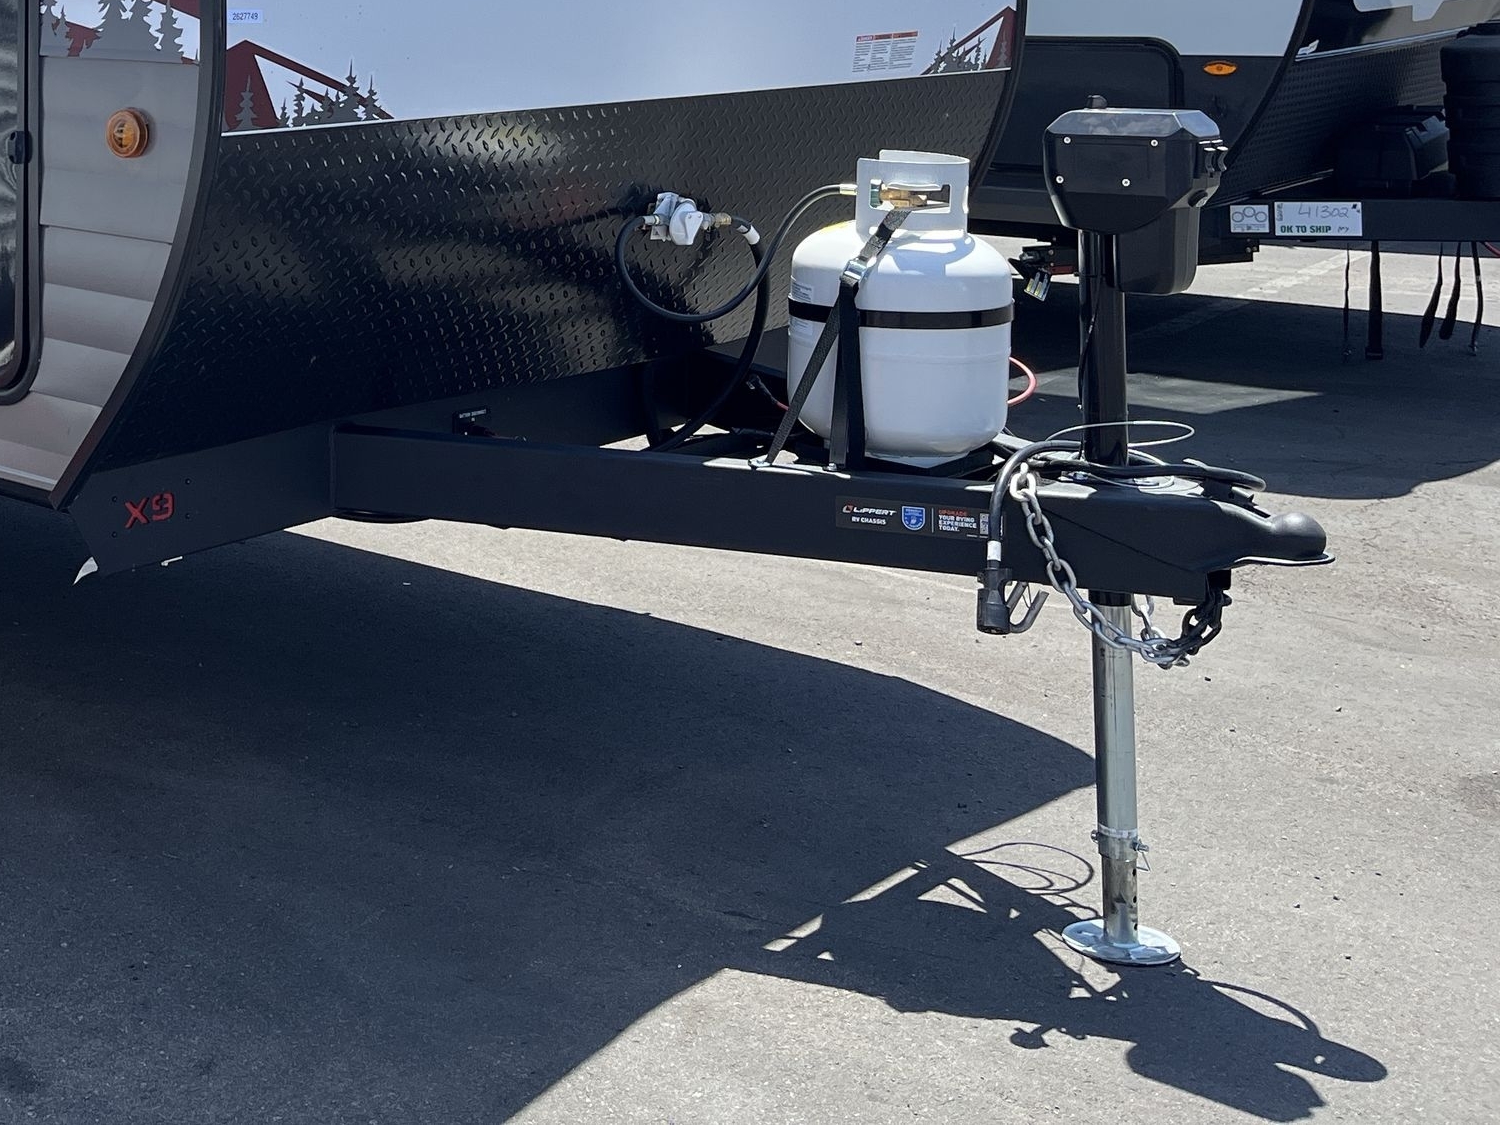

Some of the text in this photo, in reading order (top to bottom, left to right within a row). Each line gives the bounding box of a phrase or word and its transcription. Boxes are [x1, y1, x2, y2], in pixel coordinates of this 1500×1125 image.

[1280, 225, 1332, 234] OK TO SHIP
[124, 492, 174, 529] X9
[853, 506, 898, 517] LIPPERT
[860, 516, 887, 525] CHASSIS
[938, 520, 977, 528] EXPERIENCE
